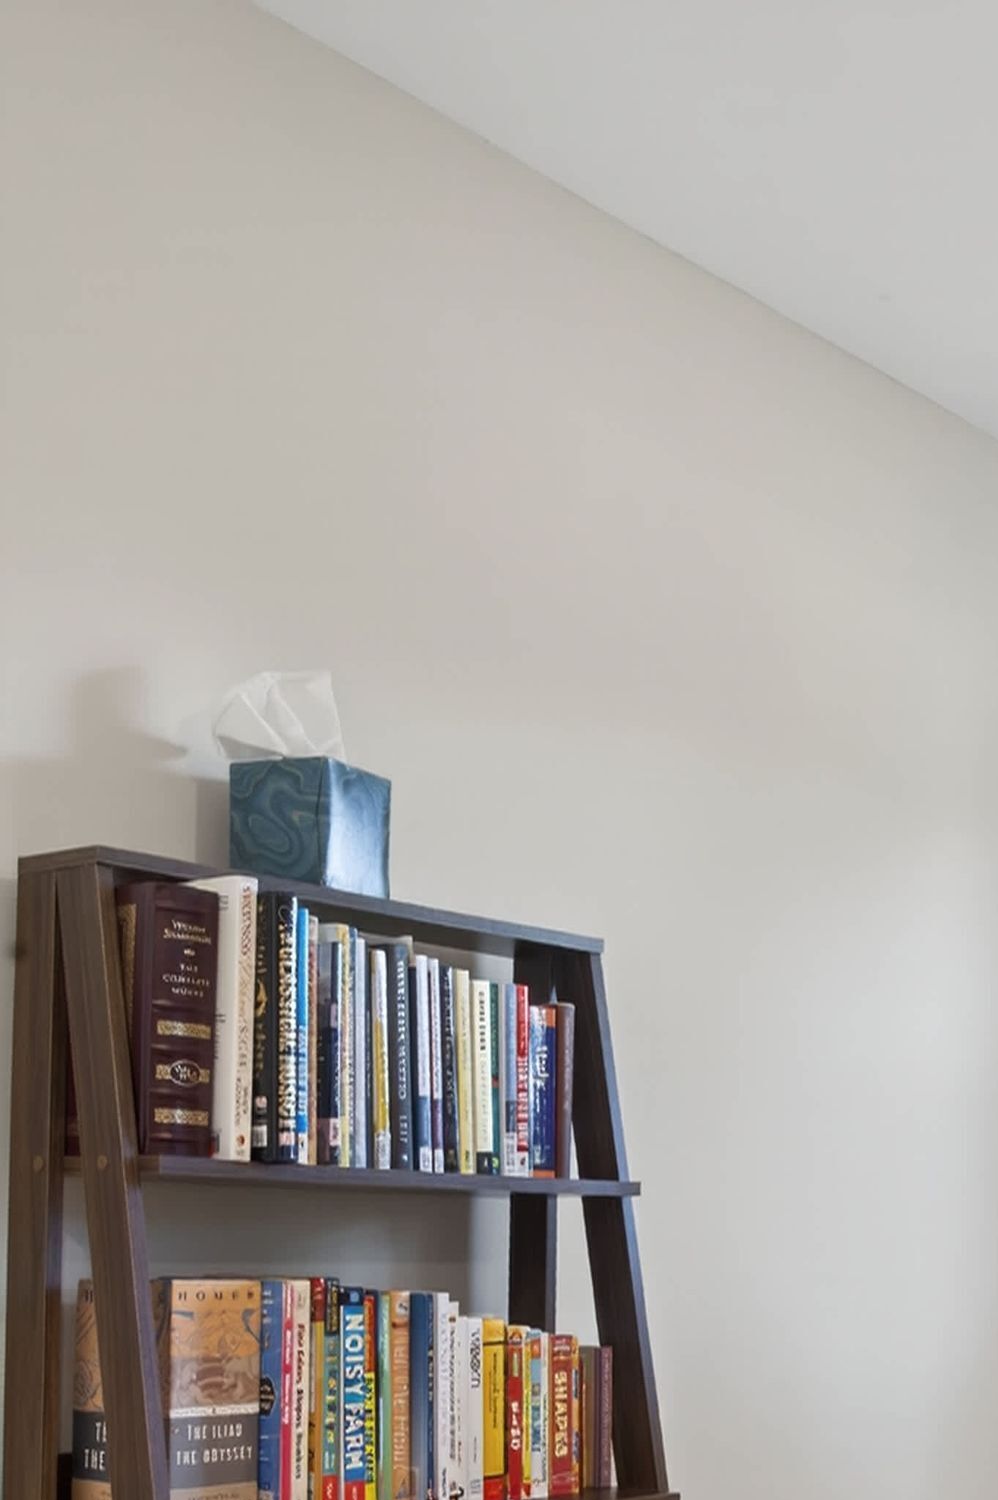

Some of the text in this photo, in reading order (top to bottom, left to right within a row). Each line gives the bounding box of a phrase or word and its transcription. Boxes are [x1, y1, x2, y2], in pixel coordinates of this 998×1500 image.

[344, 1313, 366, 1396] NOISY
[344, 1402, 365, 1470] FARM
[554, 1371, 569, 1459] SHAPES
[202, 1445, 253, 1464] ODYSSEY
